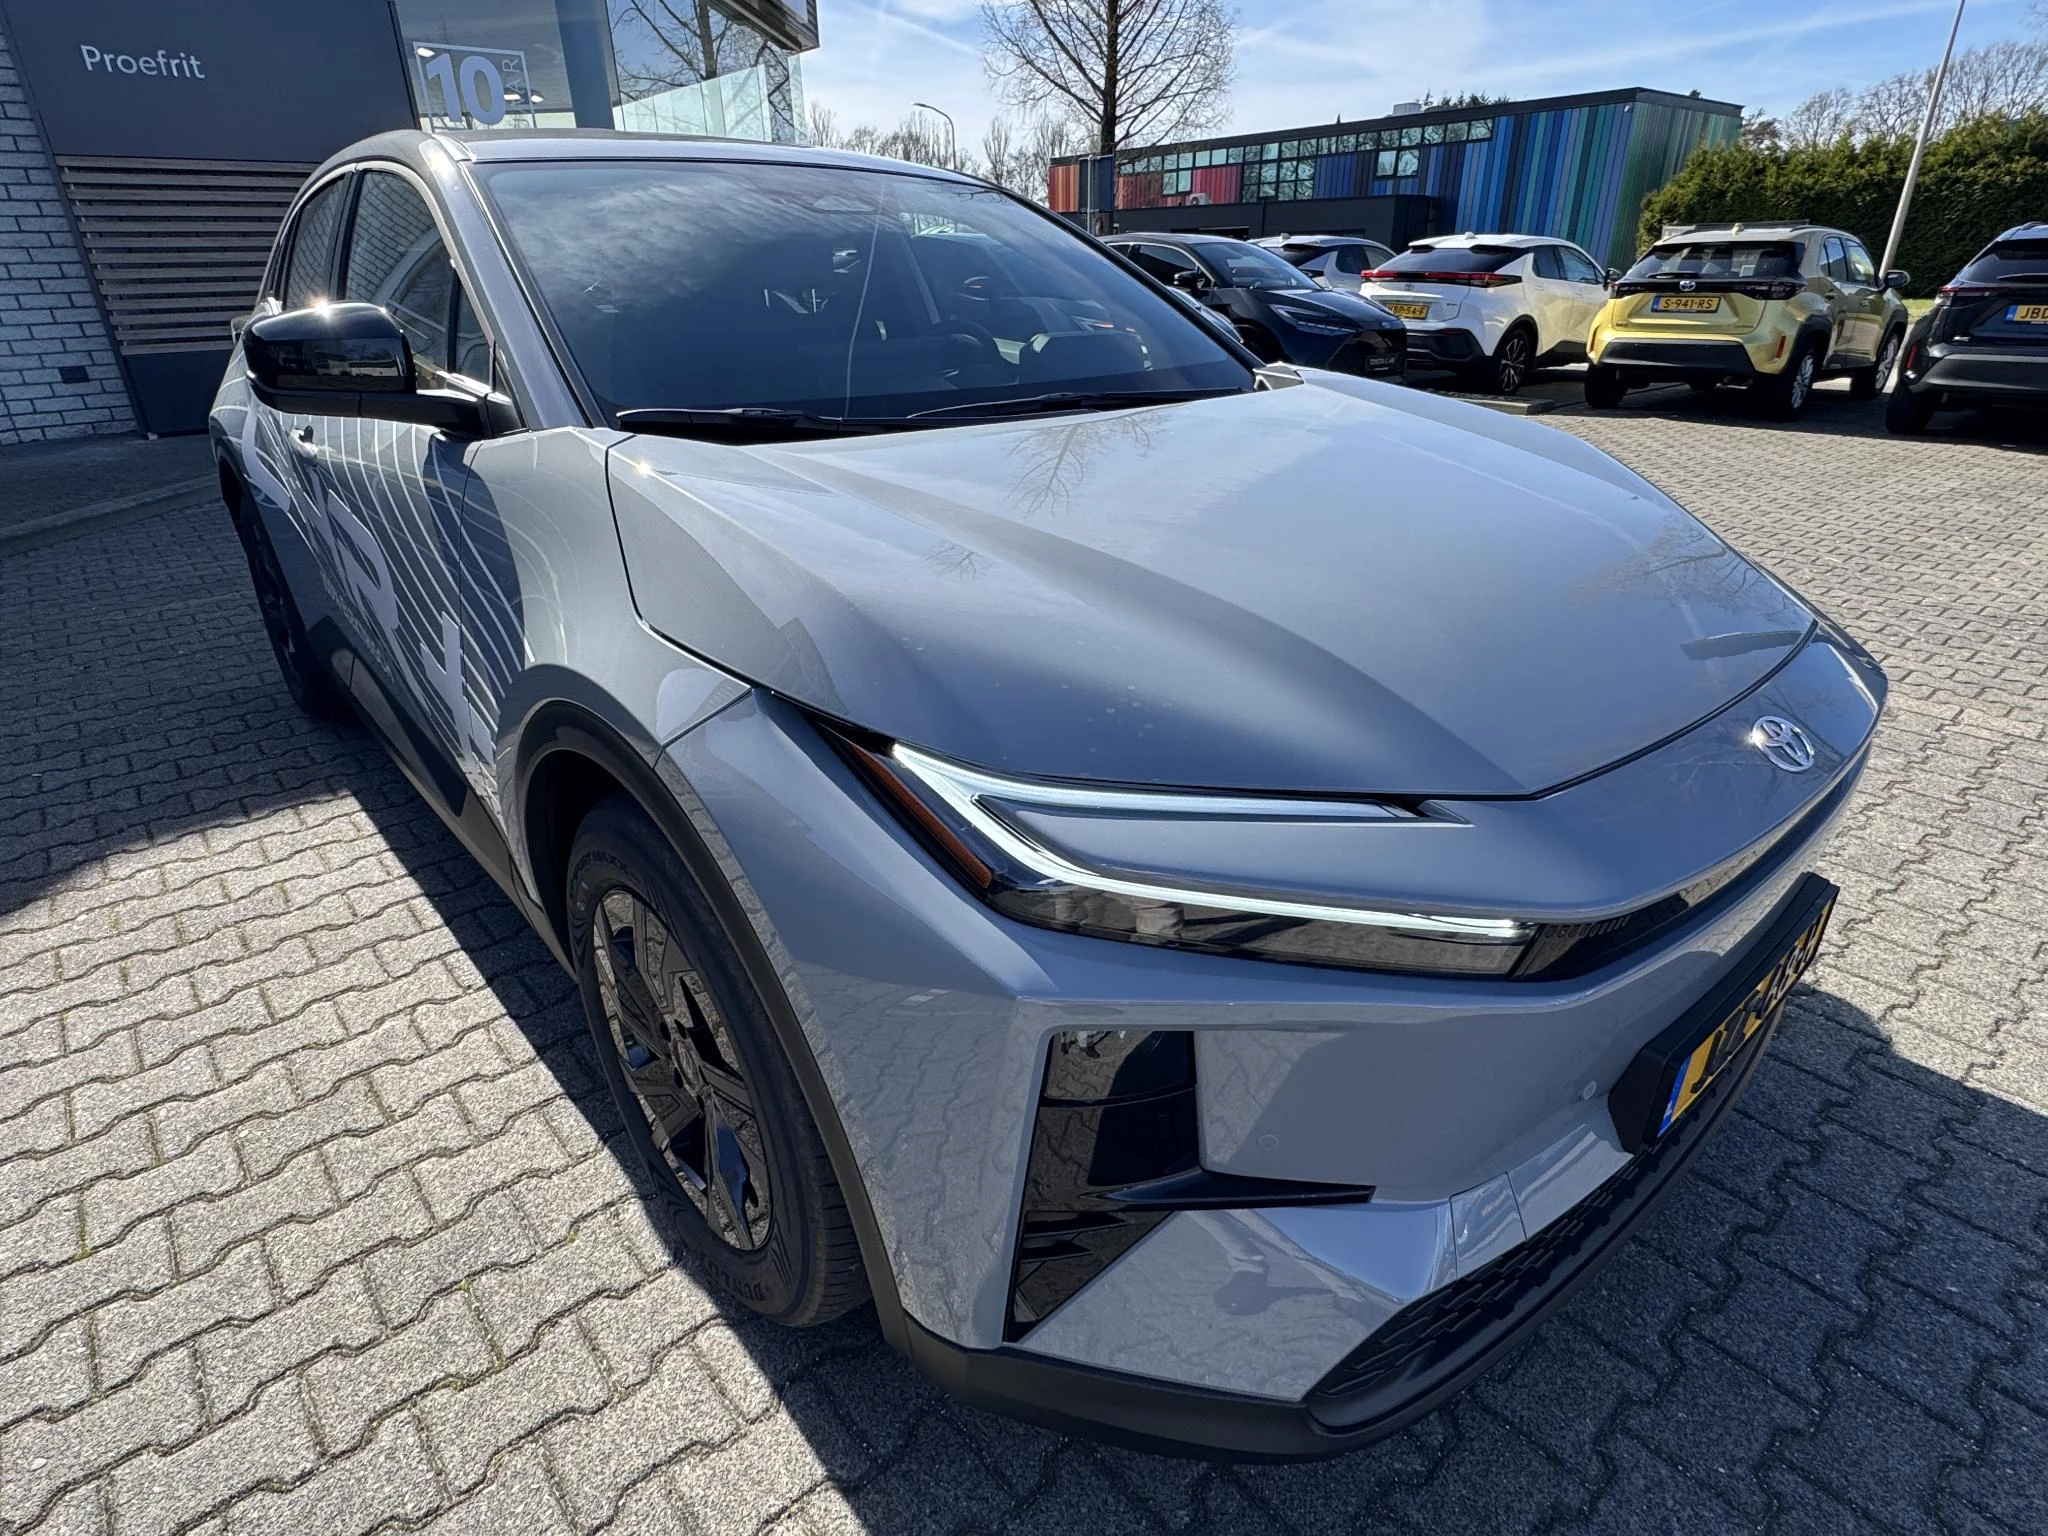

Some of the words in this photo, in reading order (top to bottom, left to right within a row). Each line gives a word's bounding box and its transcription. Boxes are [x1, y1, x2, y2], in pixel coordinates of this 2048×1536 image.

[80, 44, 205, 79] Proefrit
[426, 53, 507, 126] 10
[1663, 298, 1713, 310] S-941-RS
